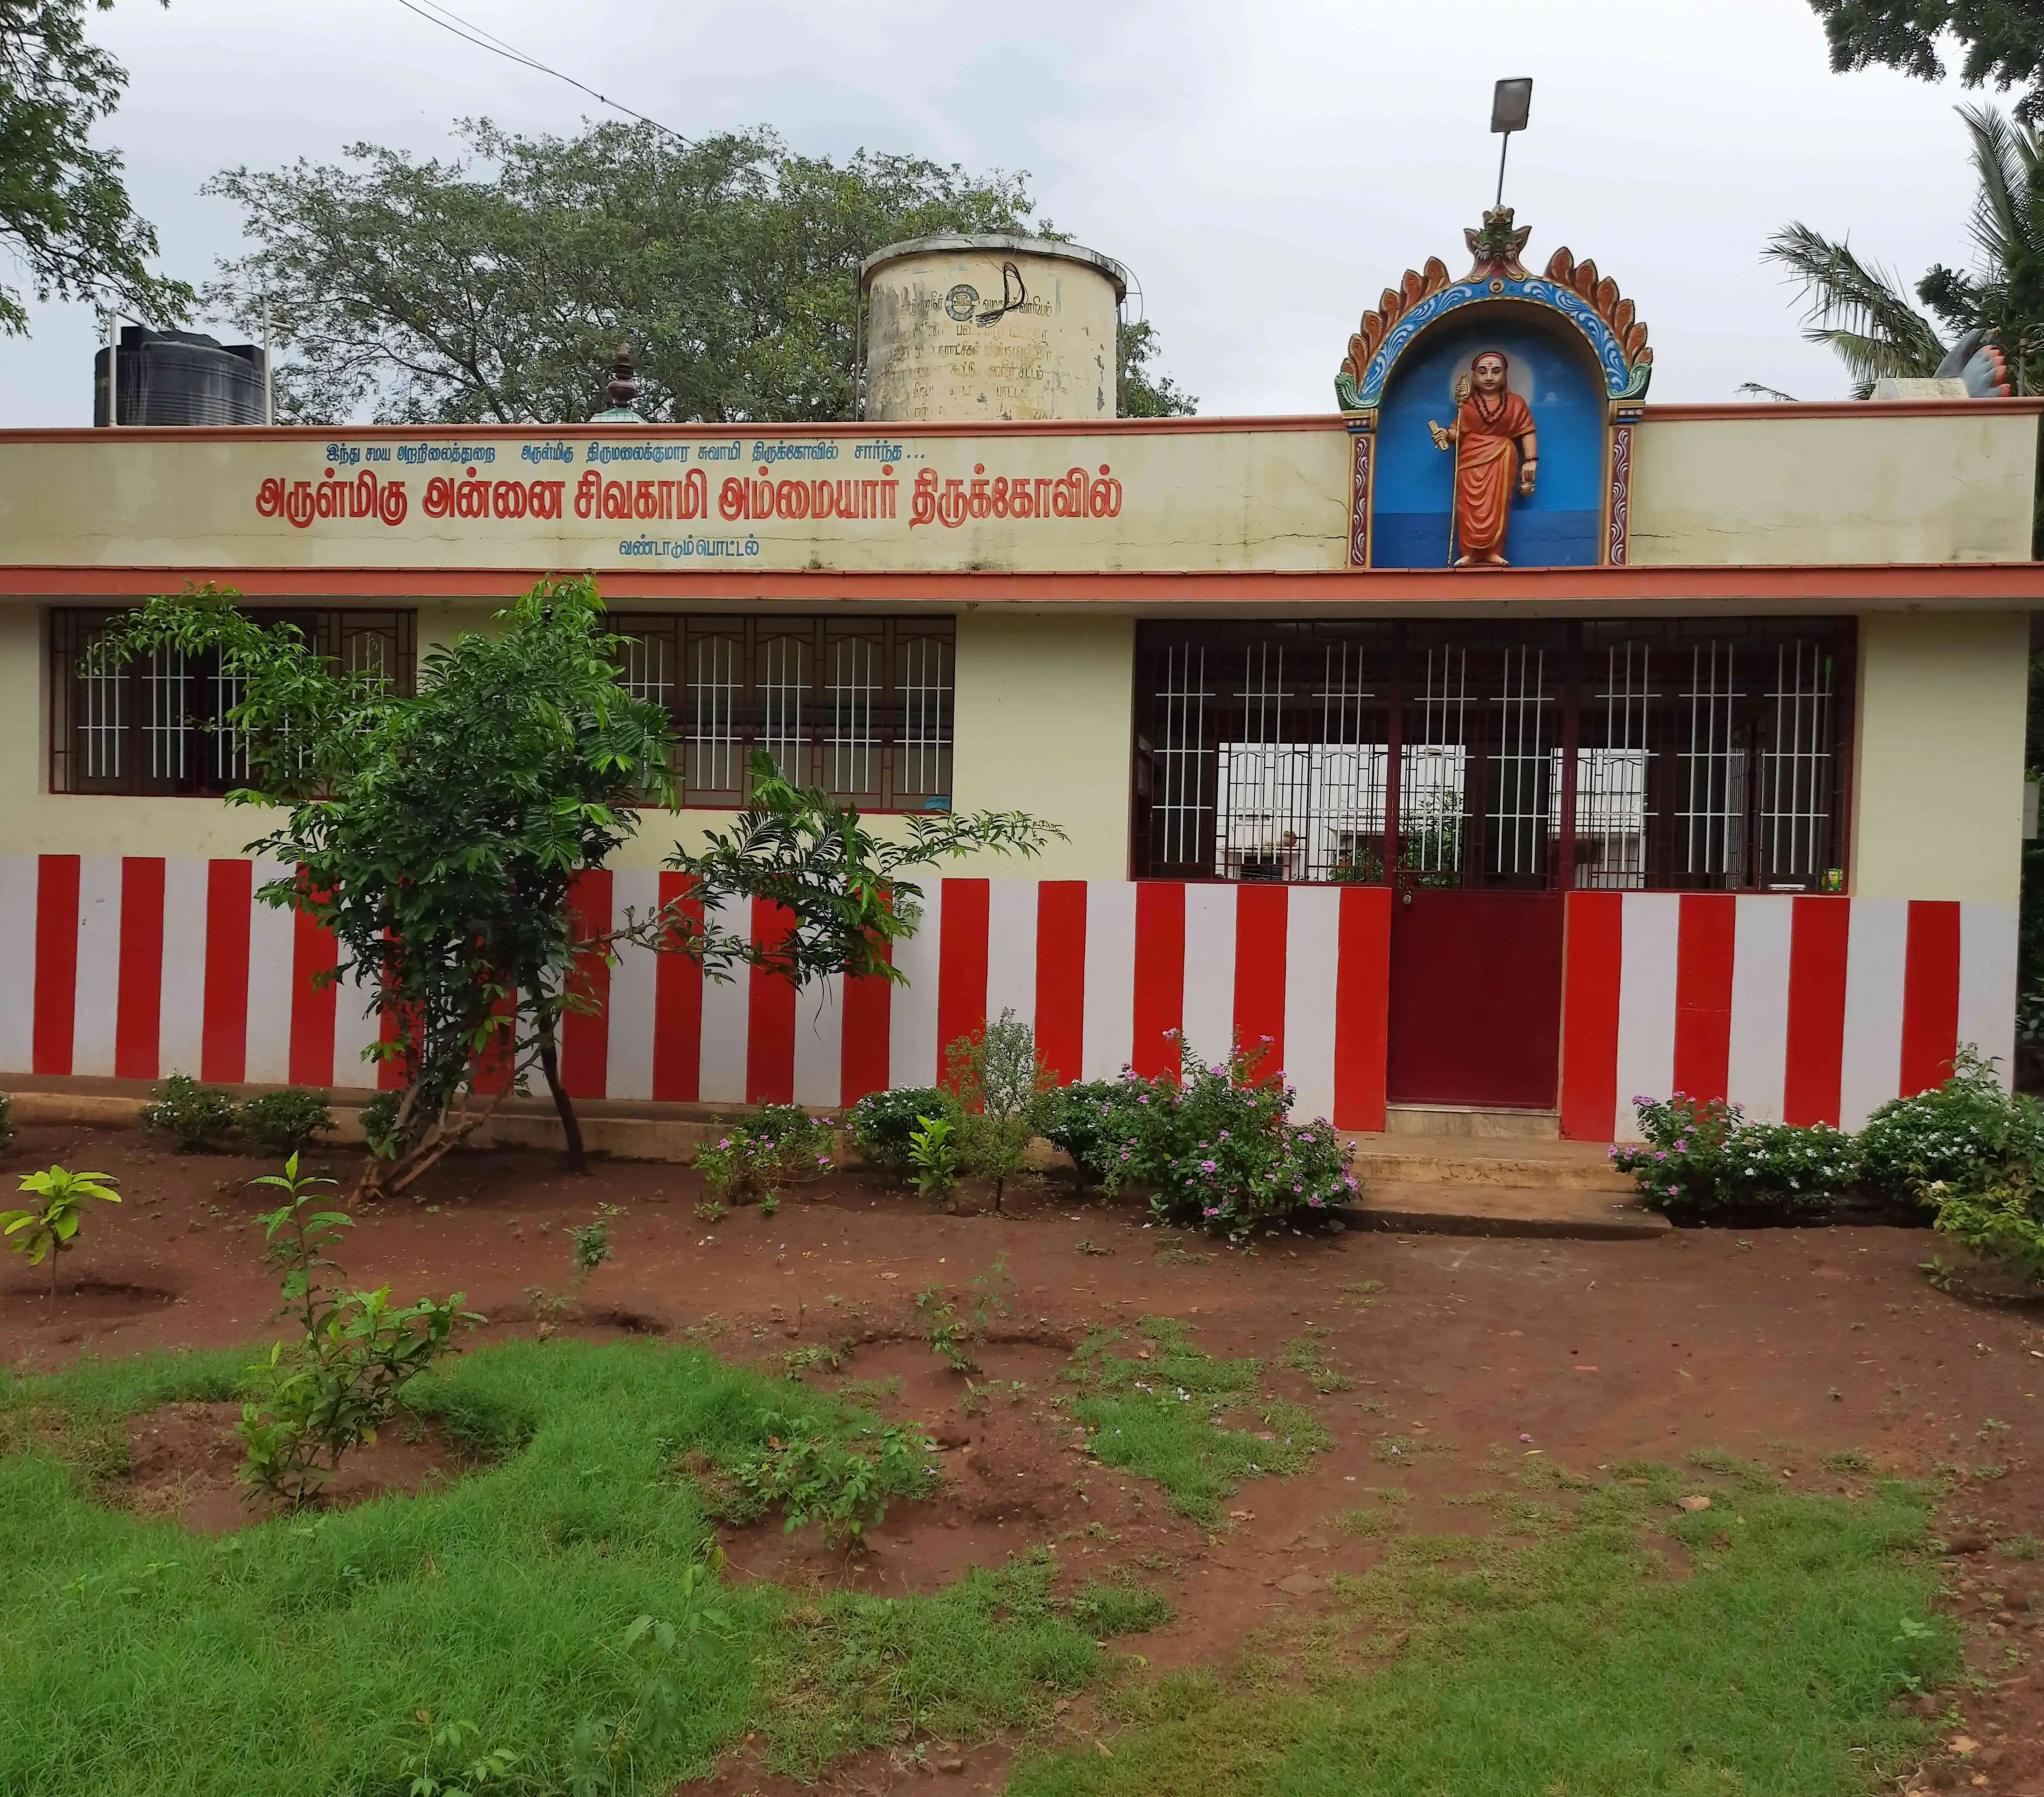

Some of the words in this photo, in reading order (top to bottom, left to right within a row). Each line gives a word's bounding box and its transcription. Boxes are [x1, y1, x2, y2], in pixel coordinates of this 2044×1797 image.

[326, 442, 361, 466] இந்து
[365, 447, 391, 462] சமய
[396, 442, 496, 465] அறநிலைத்துறை
[521, 441, 574, 465] அருள்மிகு
[586, 441, 690, 464] திருமலைக்குமார
[697, 440, 742, 461] சுவாமி
[752, 440, 838, 464] திருக்கோவில்
[256, 467, 408, 529] அருள்மிகு
[422, 467, 566, 520] அன்னை
[573, 468, 707, 520] சிவகாமி
[718, 465, 899, 521] அம்மையார்
[908, 464, 1123, 531] திருக்கோவில்
